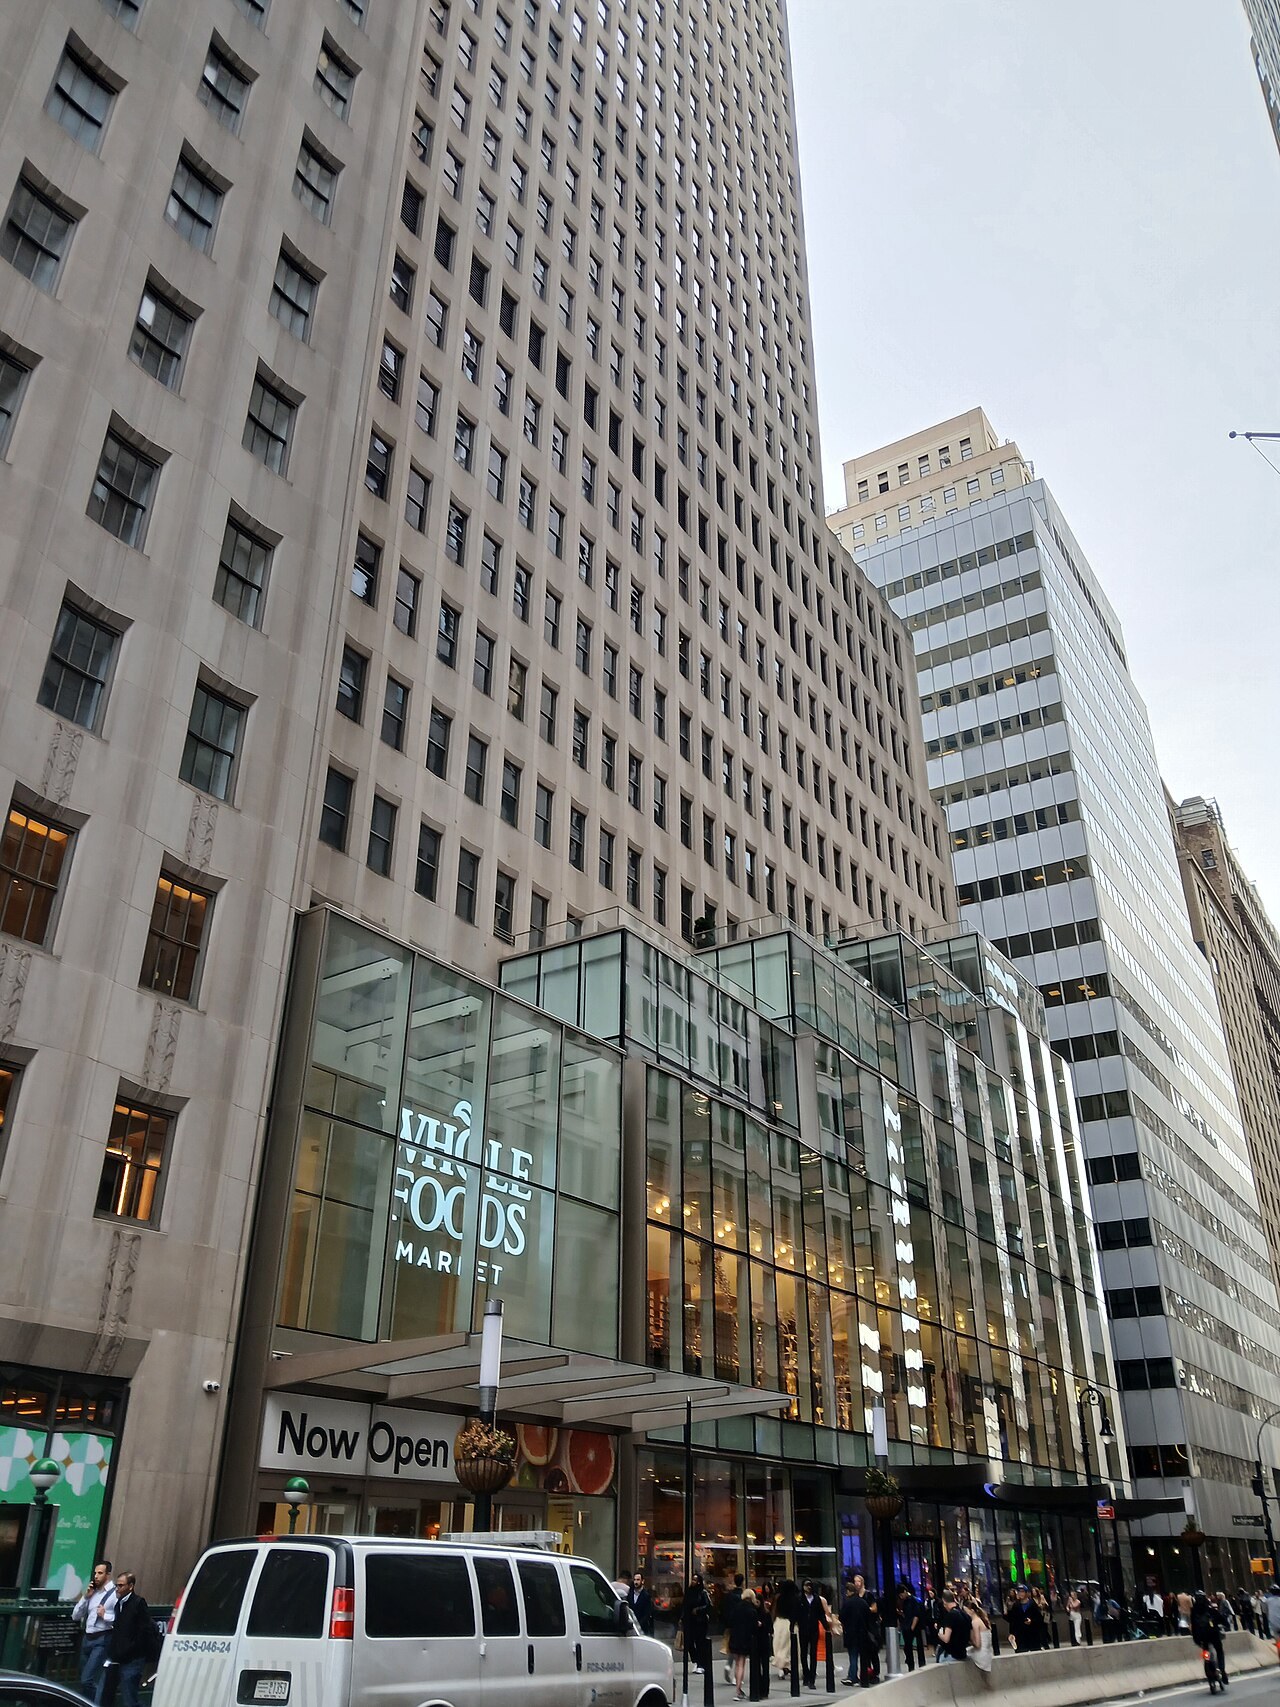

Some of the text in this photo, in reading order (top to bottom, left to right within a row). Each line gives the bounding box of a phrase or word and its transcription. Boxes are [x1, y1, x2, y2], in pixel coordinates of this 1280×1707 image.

[395, 1240, 503, 1285] MARET
[277, 1410, 448, 1474] Now Open
[172, 1640, 231, 1653] FCS-S-046-24
